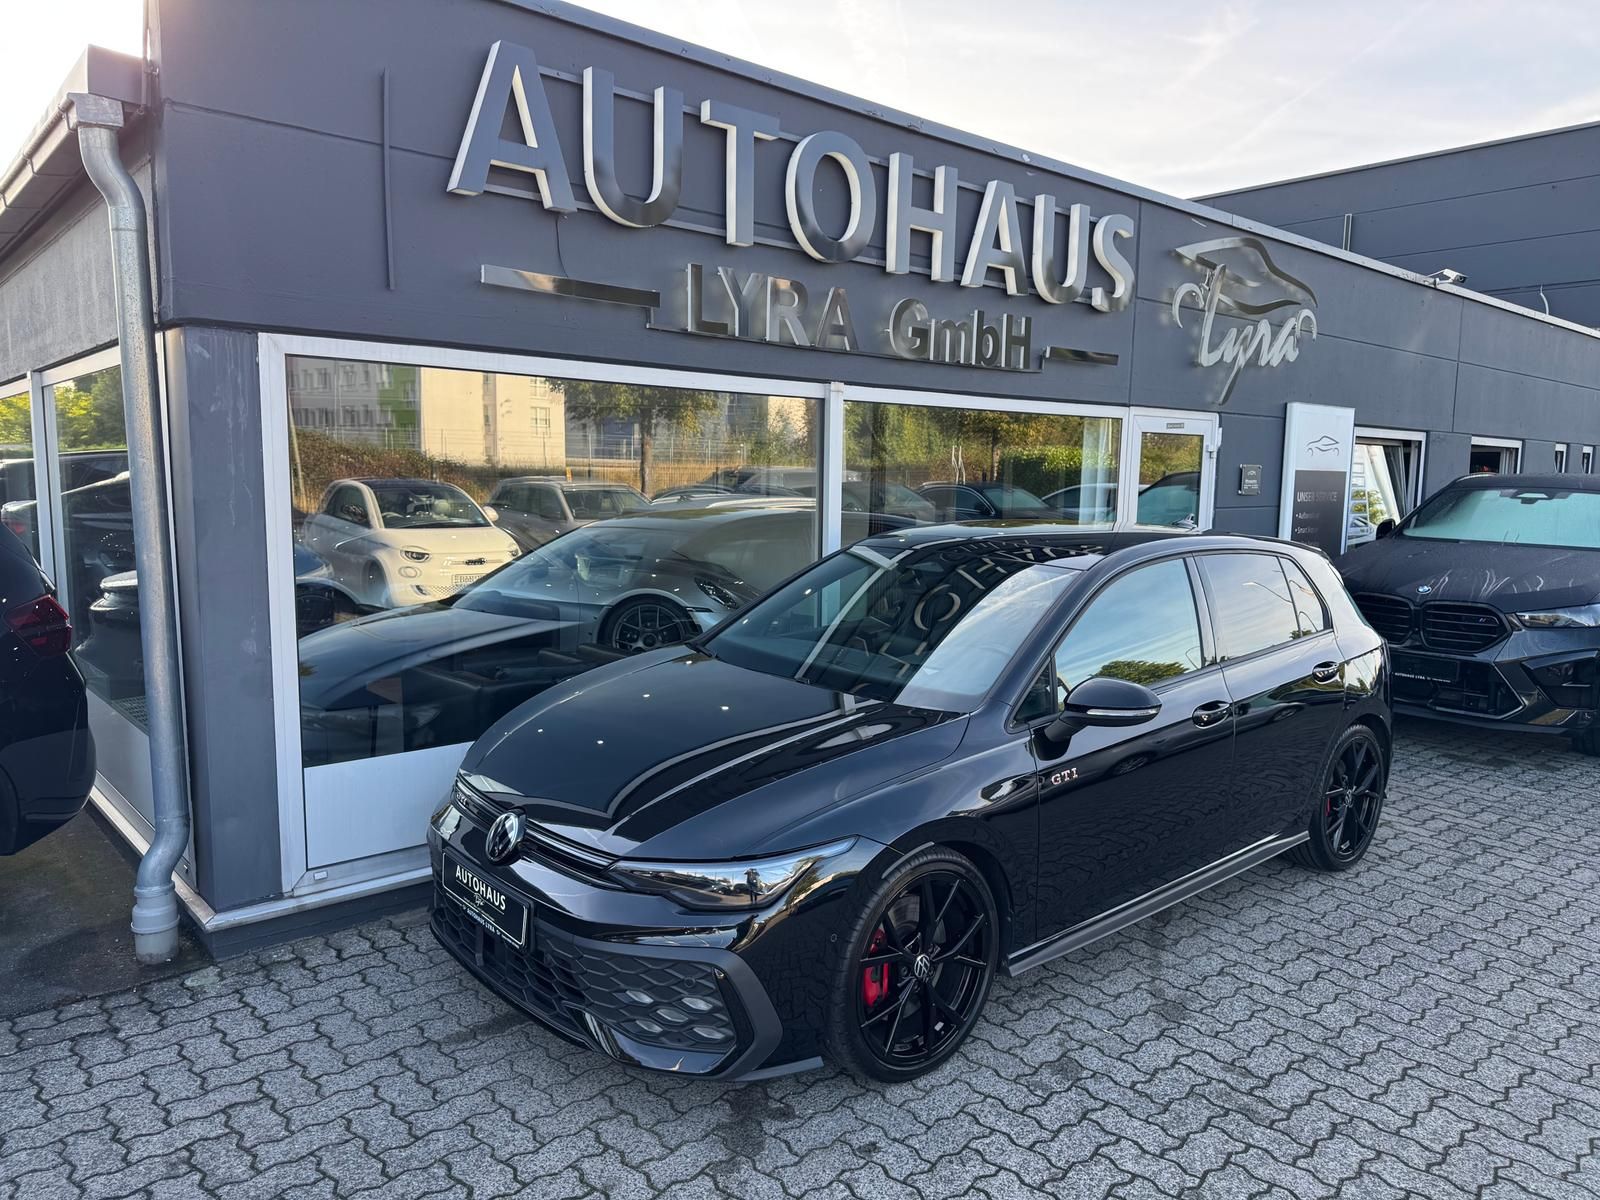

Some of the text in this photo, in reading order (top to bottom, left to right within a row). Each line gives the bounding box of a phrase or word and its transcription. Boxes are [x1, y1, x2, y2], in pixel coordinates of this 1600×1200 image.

[447, 40, 1135, 313] AUTOHAUS
[687, 263, 1033, 370] LYRA GmbH
[1051, 767, 1079, 785] GTI
[455, 864, 507, 911] AUTOHAUS
